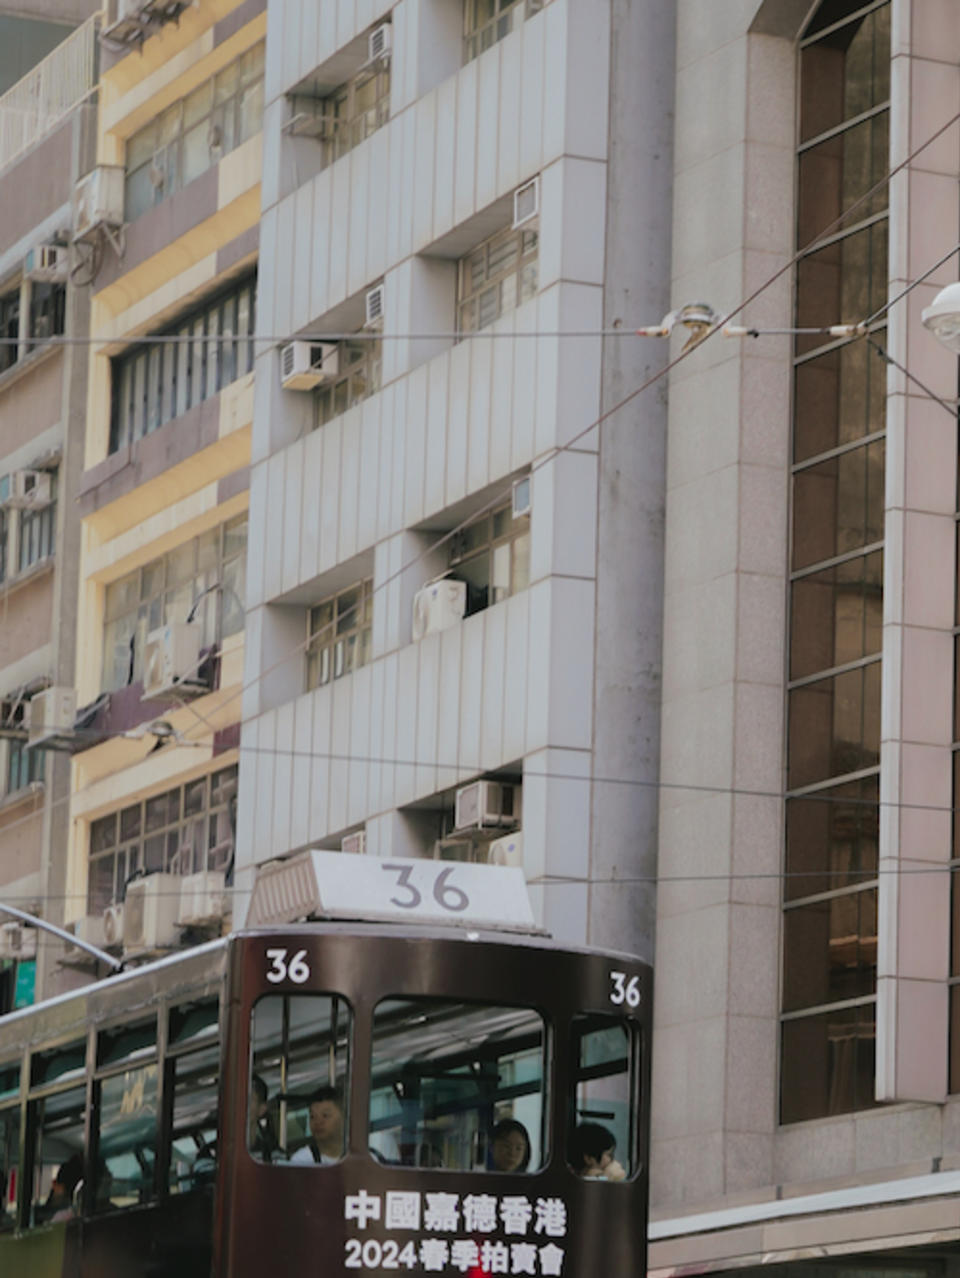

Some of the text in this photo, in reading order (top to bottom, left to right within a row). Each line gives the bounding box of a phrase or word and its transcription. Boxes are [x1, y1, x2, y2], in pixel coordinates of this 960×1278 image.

[381, 864, 469, 911] 36
[266, 949, 310, 984] 36
[609, 971, 640, 1008] 36
[344, 1189, 567, 1237] 中國嘉德香港
[344, 1238, 565, 1276] 2024春季拍賣會
